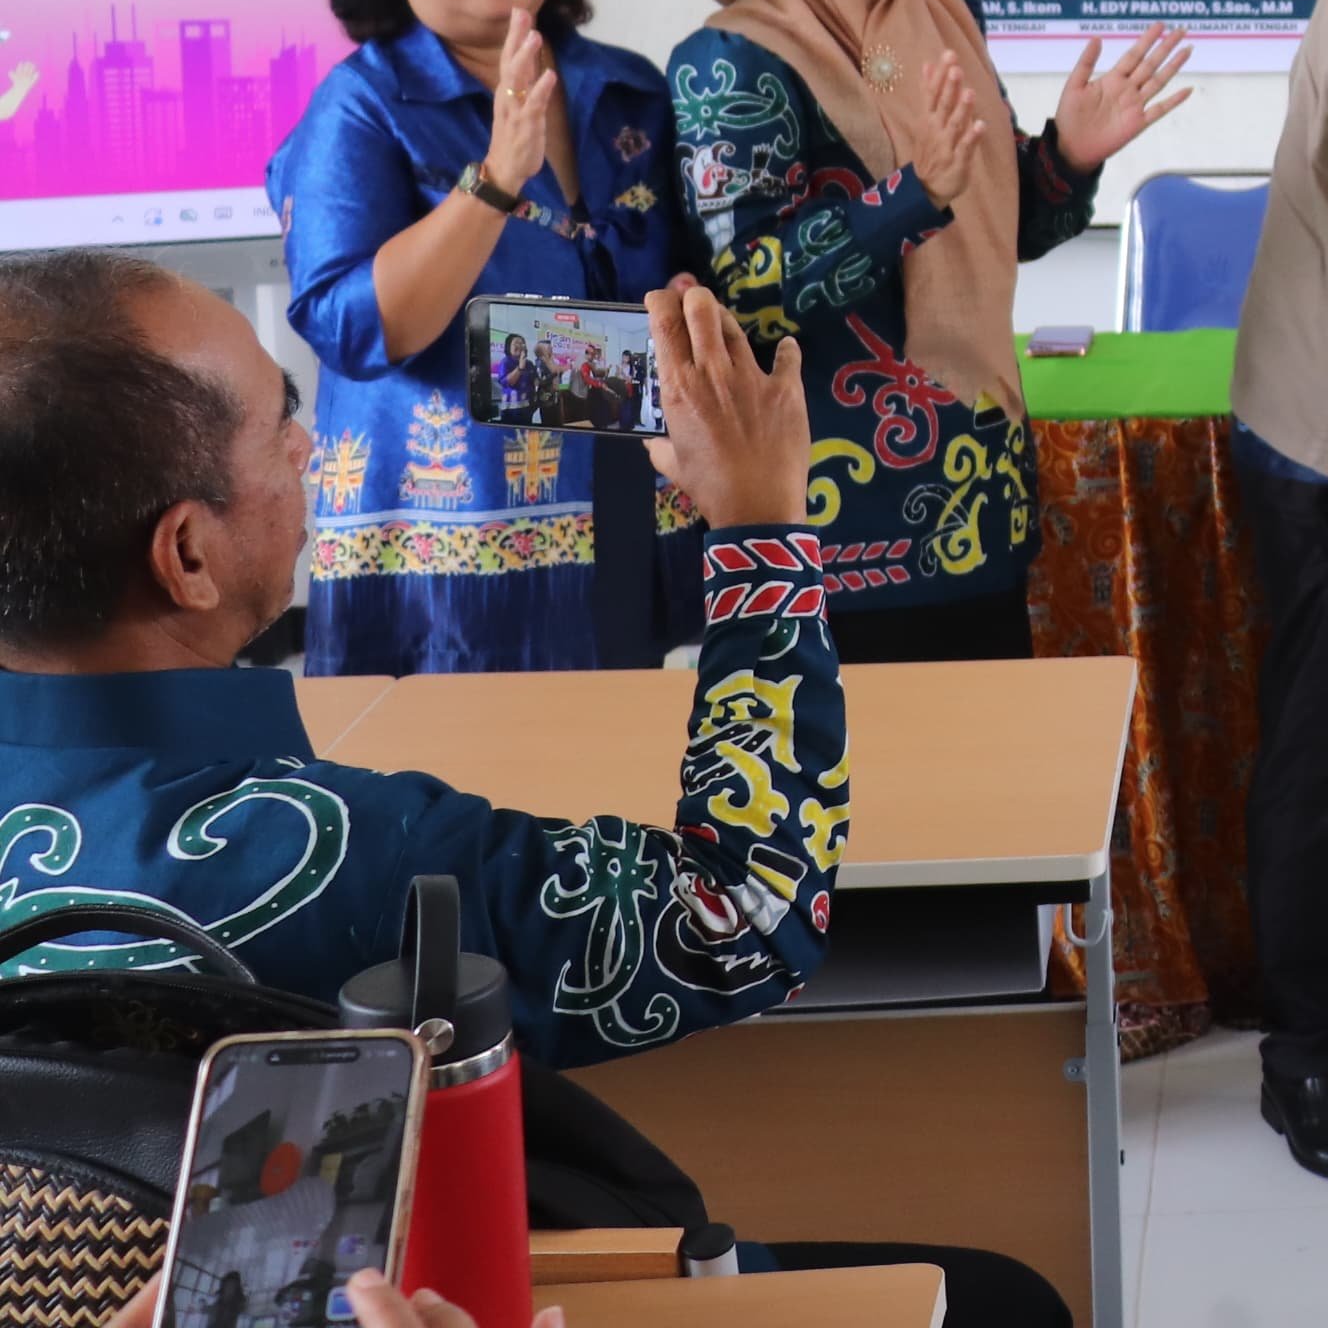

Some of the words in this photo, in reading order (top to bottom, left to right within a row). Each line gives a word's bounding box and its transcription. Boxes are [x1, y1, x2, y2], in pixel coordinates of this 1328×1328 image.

[1082, 0, 1098, 14] H.
[1100, 0, 1129, 15] EDY
[1131, 0, 1210, 16] PRATOWO,
[1261, 0, 1294, 15] M.M
